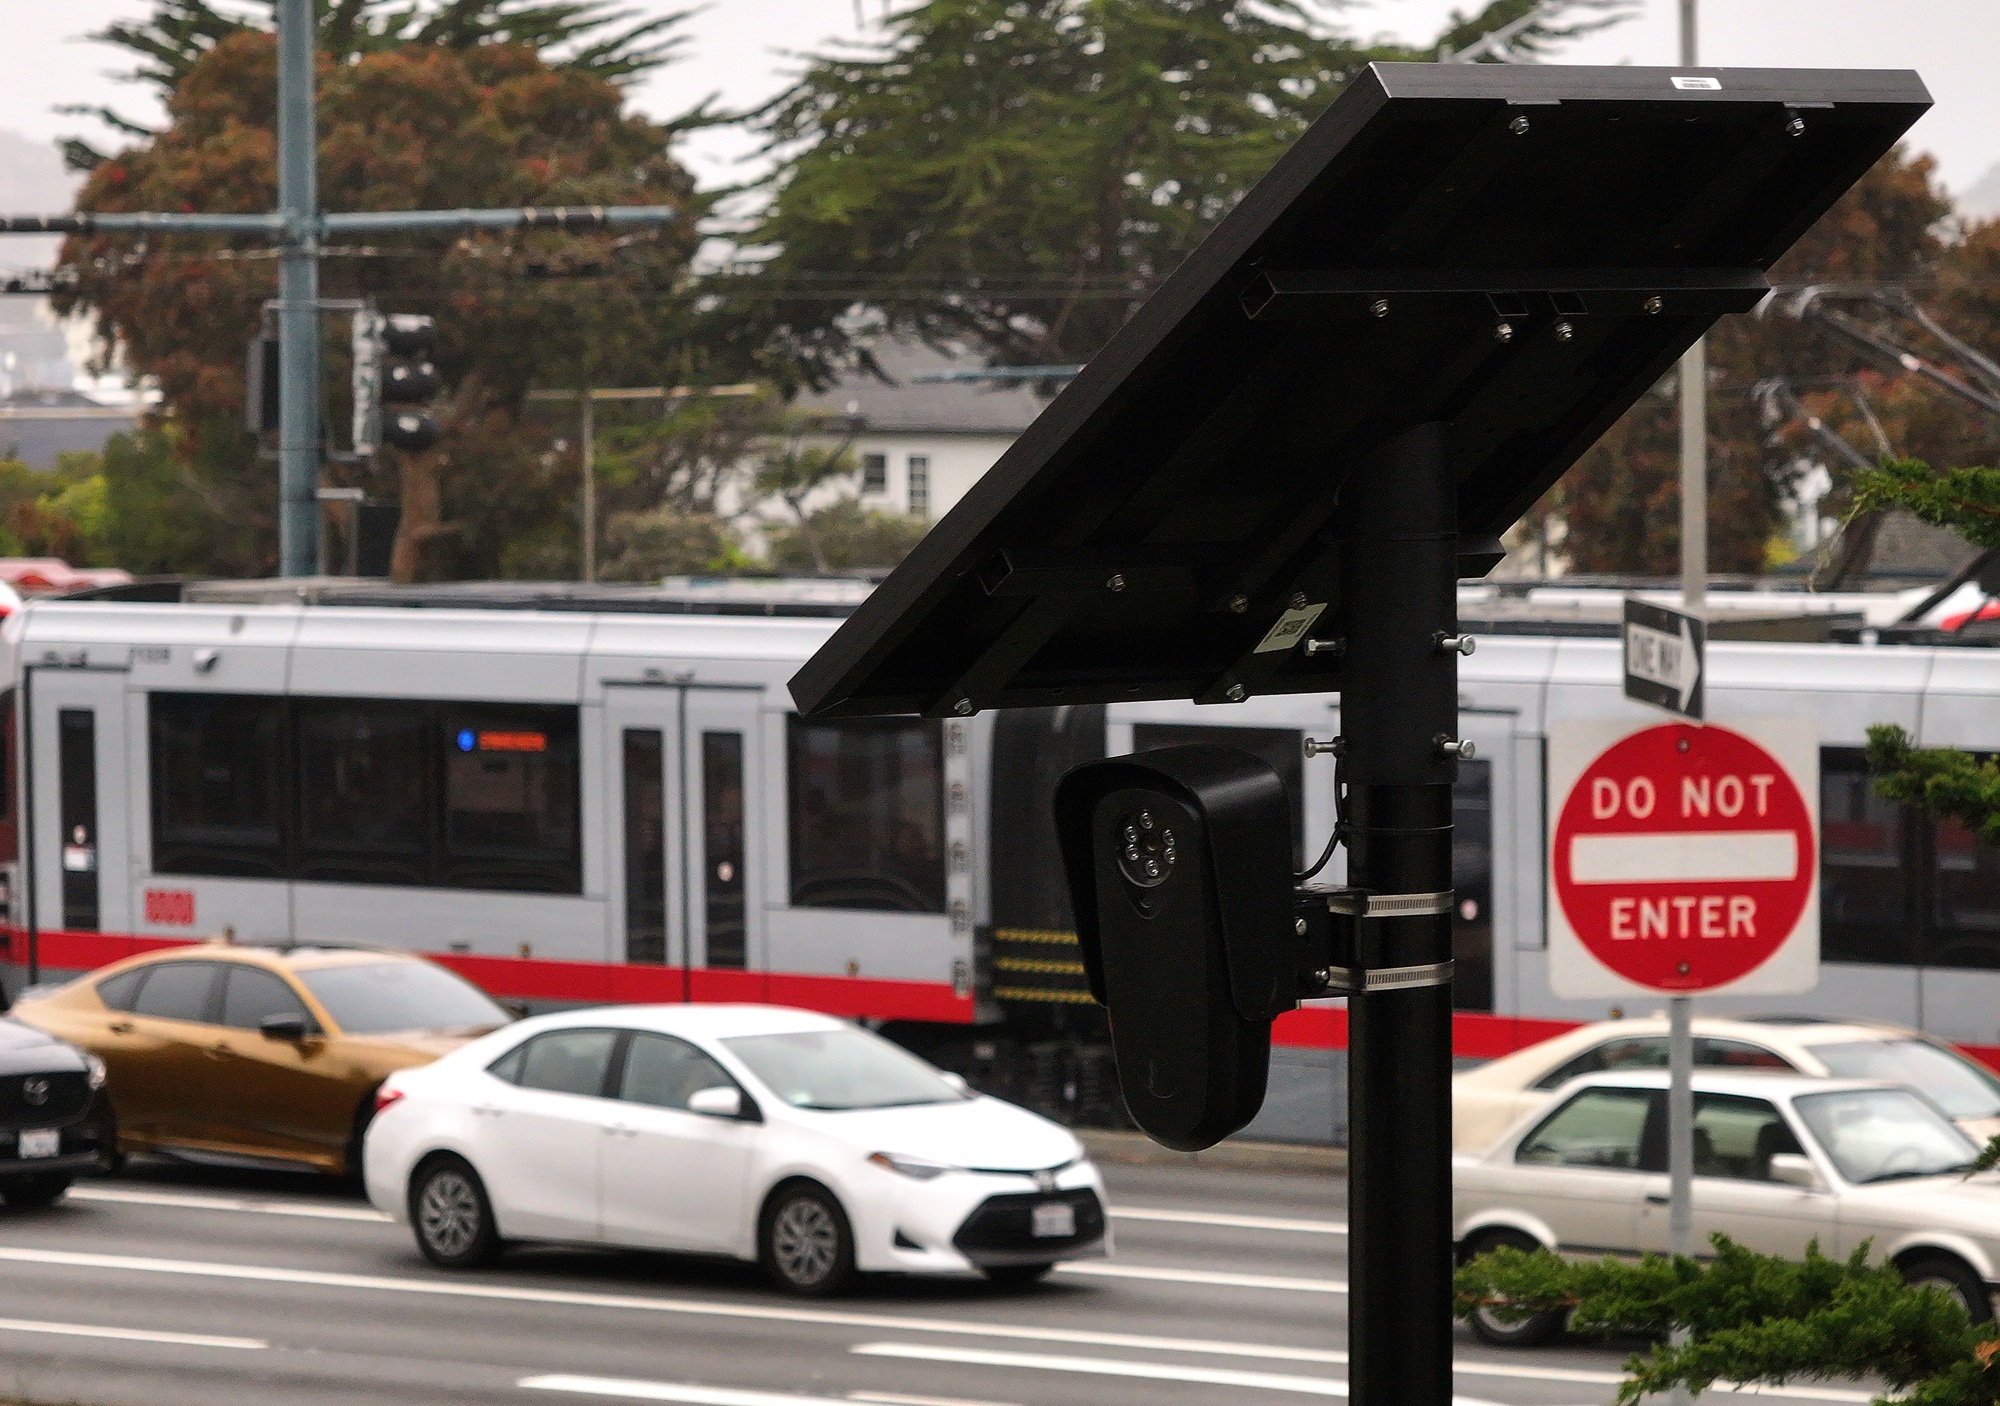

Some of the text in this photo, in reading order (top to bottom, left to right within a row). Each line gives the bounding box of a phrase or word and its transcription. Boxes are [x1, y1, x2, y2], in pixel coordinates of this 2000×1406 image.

[1592, 774, 1775, 819] DO NOT
[1610, 895, 1757, 940] ENTER
